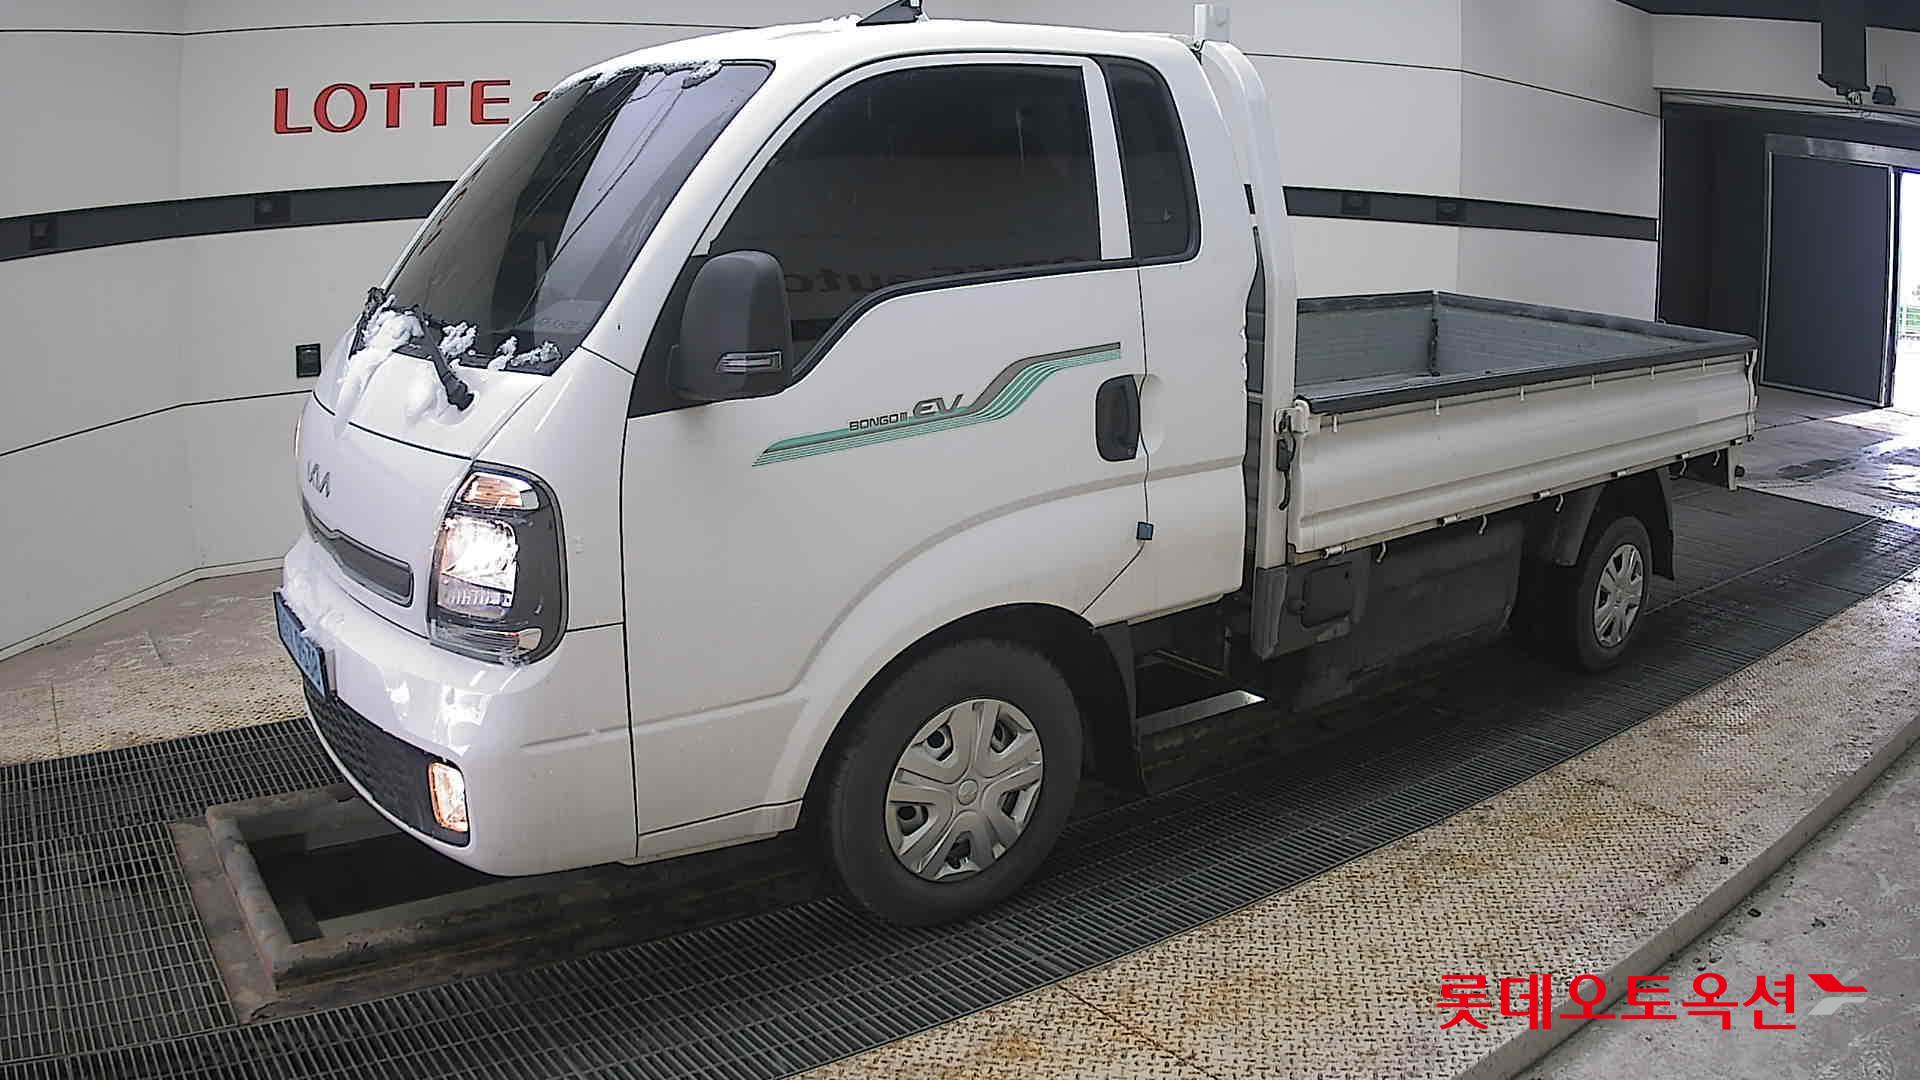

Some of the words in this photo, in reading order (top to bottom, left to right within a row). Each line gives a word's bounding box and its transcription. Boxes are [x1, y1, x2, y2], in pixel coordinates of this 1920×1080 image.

[273, 79, 511, 134] LOTTE
[849, 413, 899, 431] BONGO
[912, 393, 964, 417] EV
